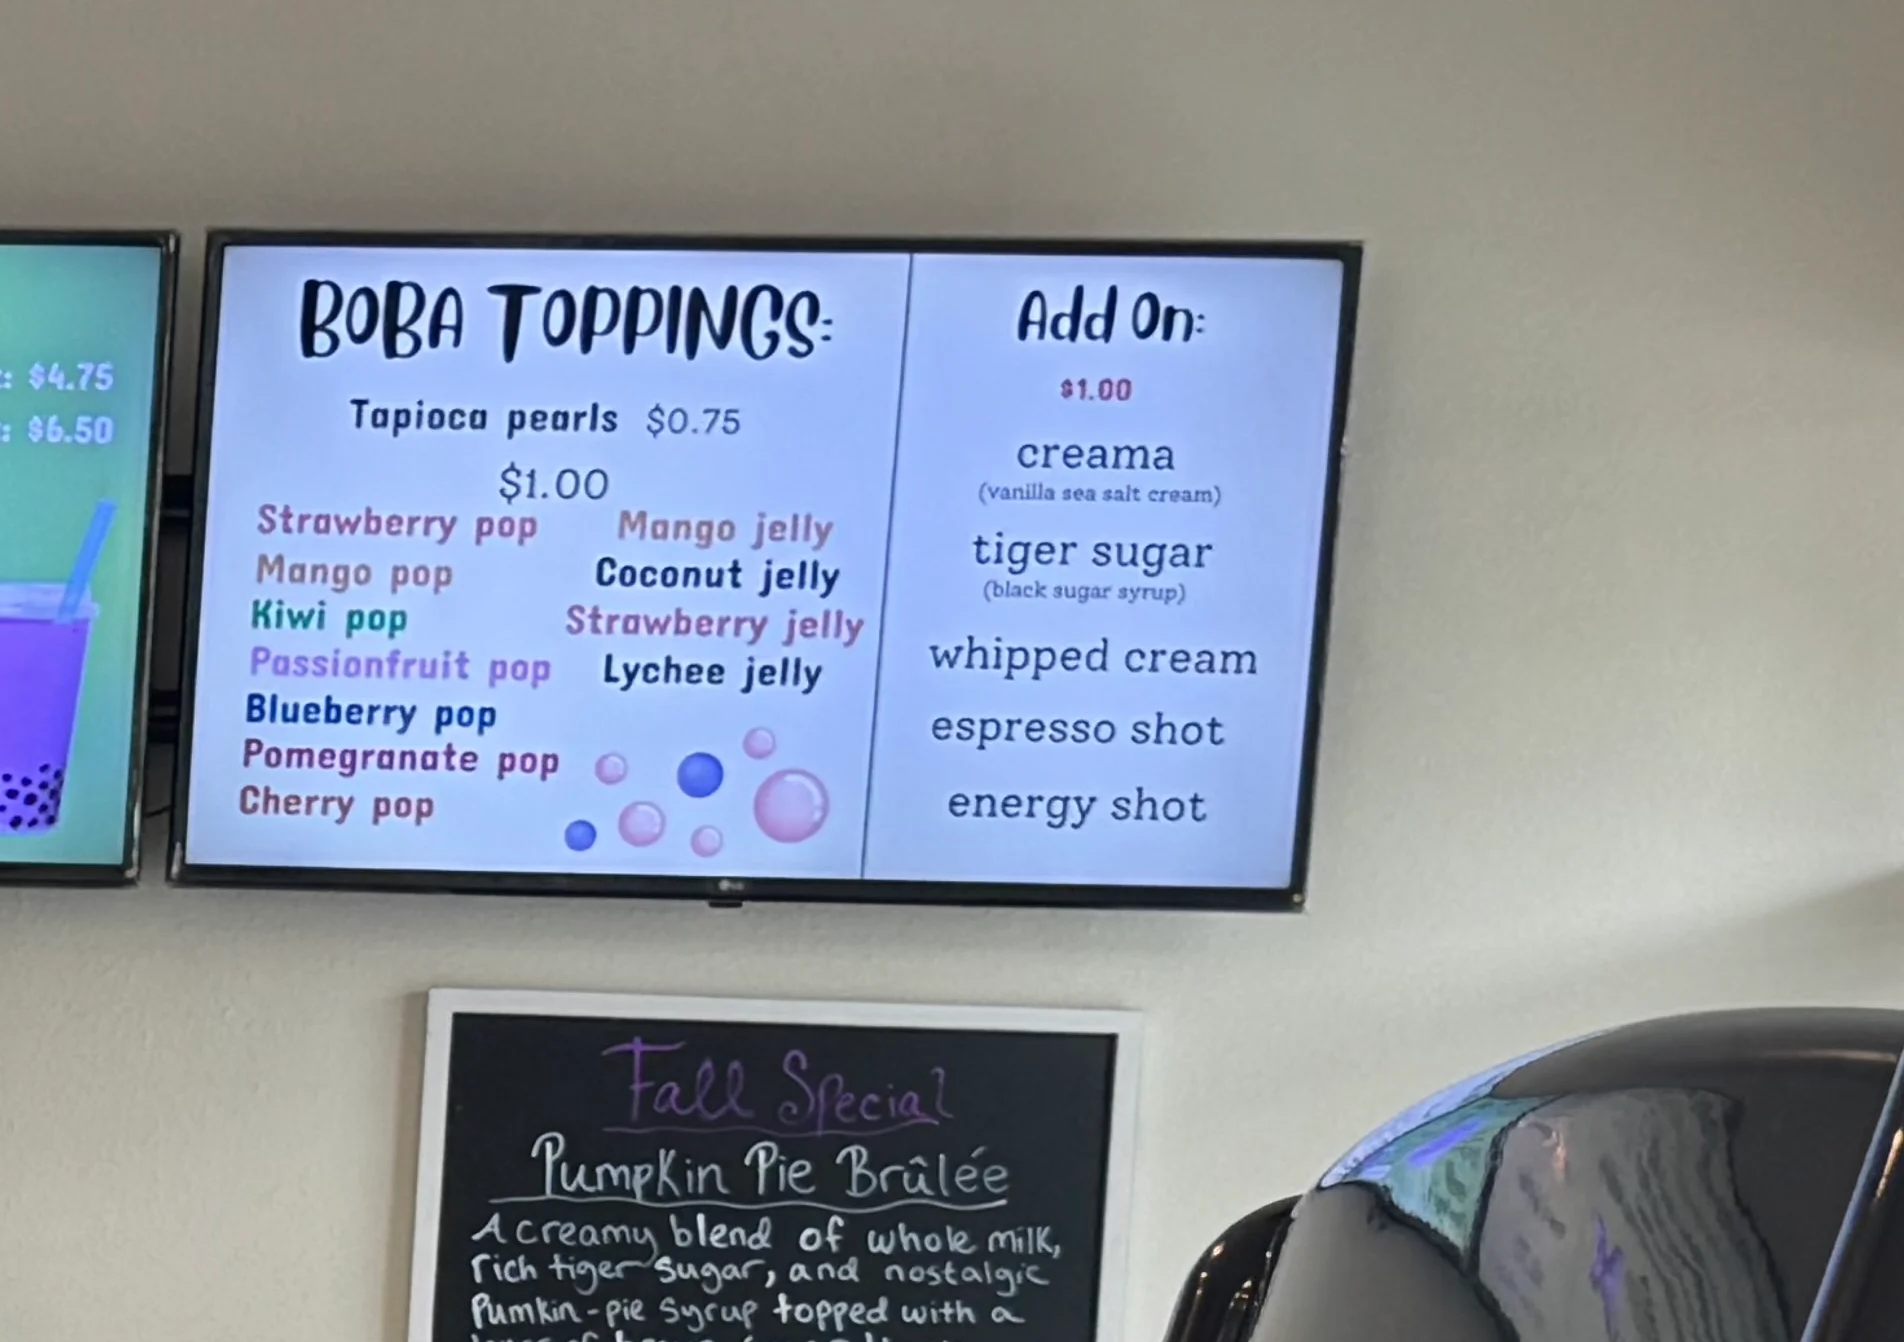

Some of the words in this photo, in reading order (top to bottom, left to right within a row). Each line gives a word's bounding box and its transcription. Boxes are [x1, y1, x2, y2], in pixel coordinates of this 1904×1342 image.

[300, 278, 464, 360] BOBA
[486, 283, 833, 364] TOPPINGS:
[1017, 284, 1118, 344] Add
[1131, 291, 1205, 343] On:
[1059, 377, 1133, 402] $1.00
[349, 398, 488, 438] Tapioca
[507, 402, 618, 440] pearls
[646, 403, 741, 439] $0.75
[1016, 442, 1176, 471] creama
[499, 461, 609, 505] $1.00
[977, 481, 1057, 506] (vanilla
[1061, 487, 1097, 503] sea
[1101, 483, 1142, 503] salt
[1146, 484, 1223, 508] cream)
[257, 503, 458, 545] Strawberry
[475, 516, 537, 546] pop
[251, 599, 326, 630] Kiwi
[345, 609, 407, 640] pop
[931, 717, 1116, 751] espresso
[1130, 711, 1224, 746] shot
[603, 1036, 755, 1121] Fall
[782, 1051, 954, 1130] Special
[745, 1142, 817, 1195] Pie
[471, 1219, 510, 1243] A
[517, 1222, 658, 1269] creamy
[671, 1215, 771, 1249] blend
[800, 1215, 844, 1253] of
[868, 1223, 975, 1255] whole
[471, 1257, 537, 1281] rich
[549, 1256, 628, 1294] tiger
[656, 1256, 776, 1294] sugar,
[790, 1257, 859, 1282] and
[885, 1261, 1050, 1295] nostalgic
